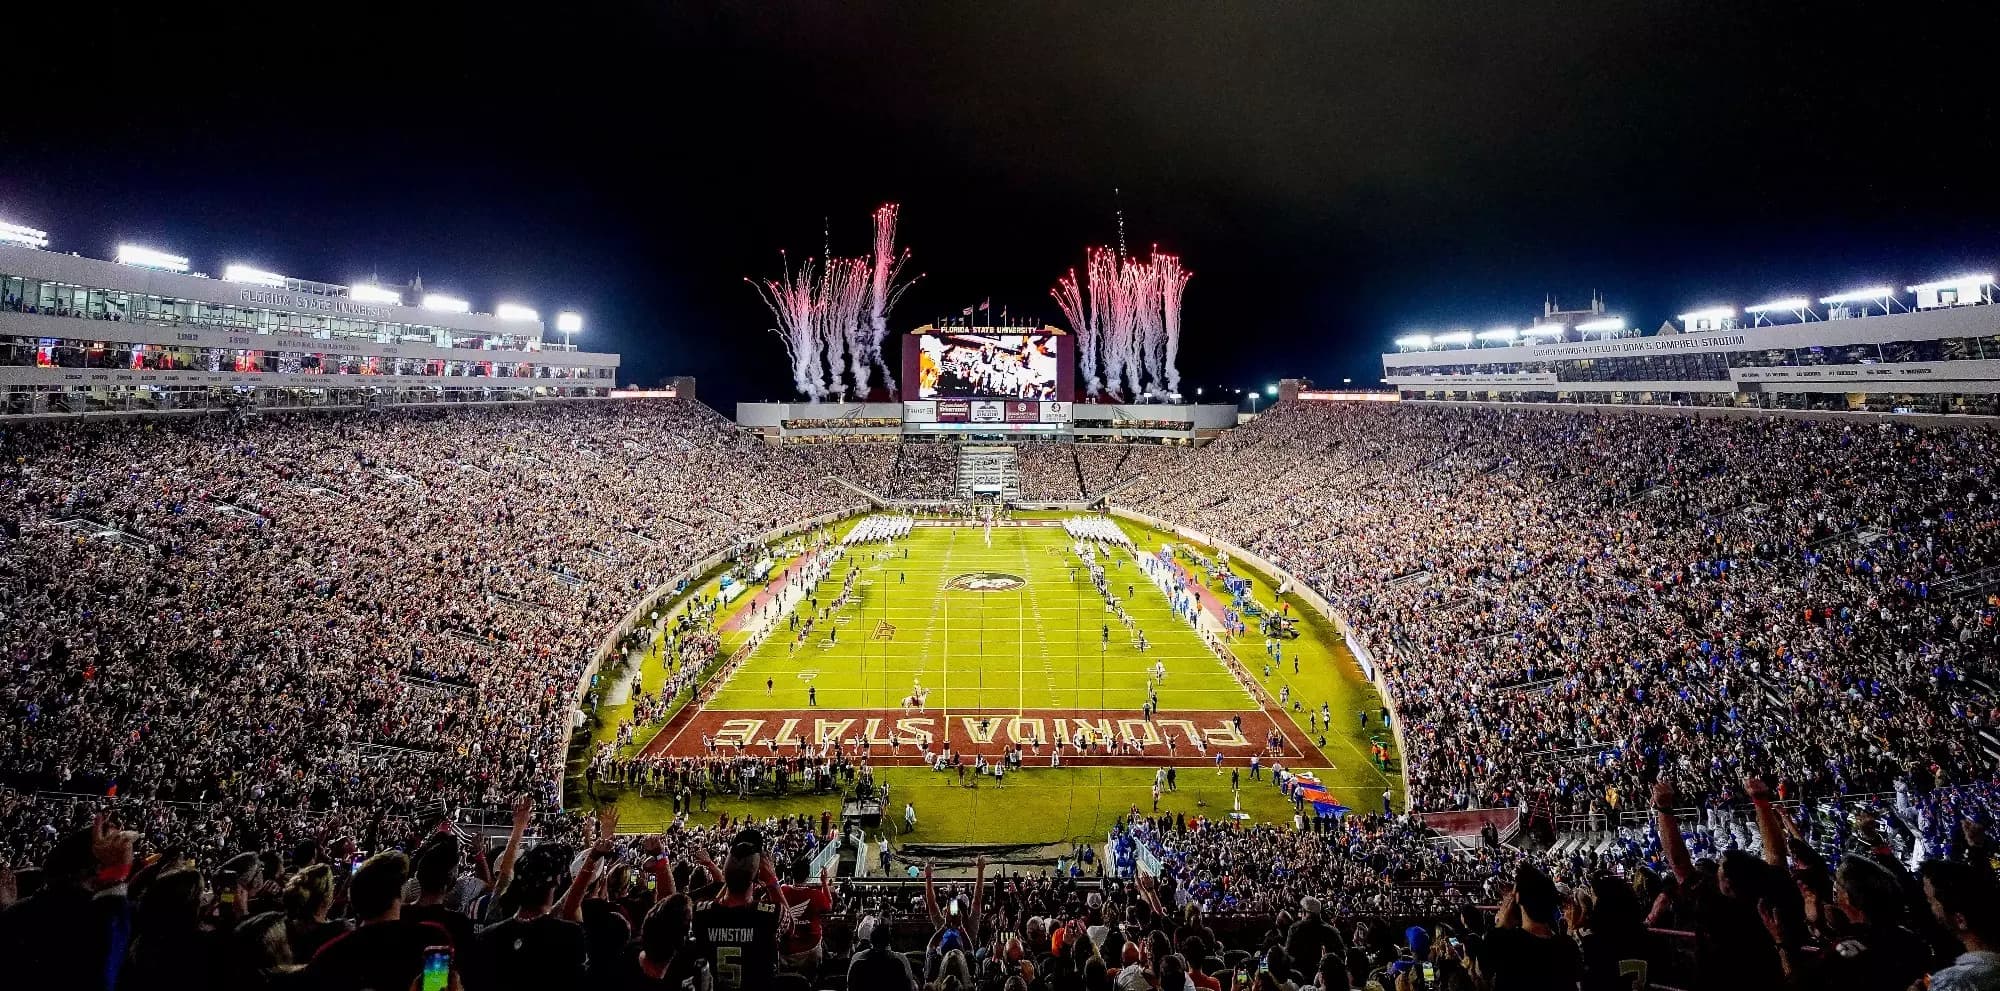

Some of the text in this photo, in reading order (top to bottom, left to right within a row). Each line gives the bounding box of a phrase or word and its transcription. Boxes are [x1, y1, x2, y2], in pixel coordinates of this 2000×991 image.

[240, 288, 290, 306] FLORIDA
[296, 296, 332, 312] STATE
[940, 326, 1037, 334] FLORIDA STATE UNIVERSITY
[1612, 344, 1621, 352] AT
[1655, 338, 1699, 350] CAMPBELL
[1701, 335, 1745, 348] STADIUM
[715, 717, 1252, 747] FLORIDA STATE
[708, 927, 754, 942] WINSTON
[716, 946, 742, 989] 5
